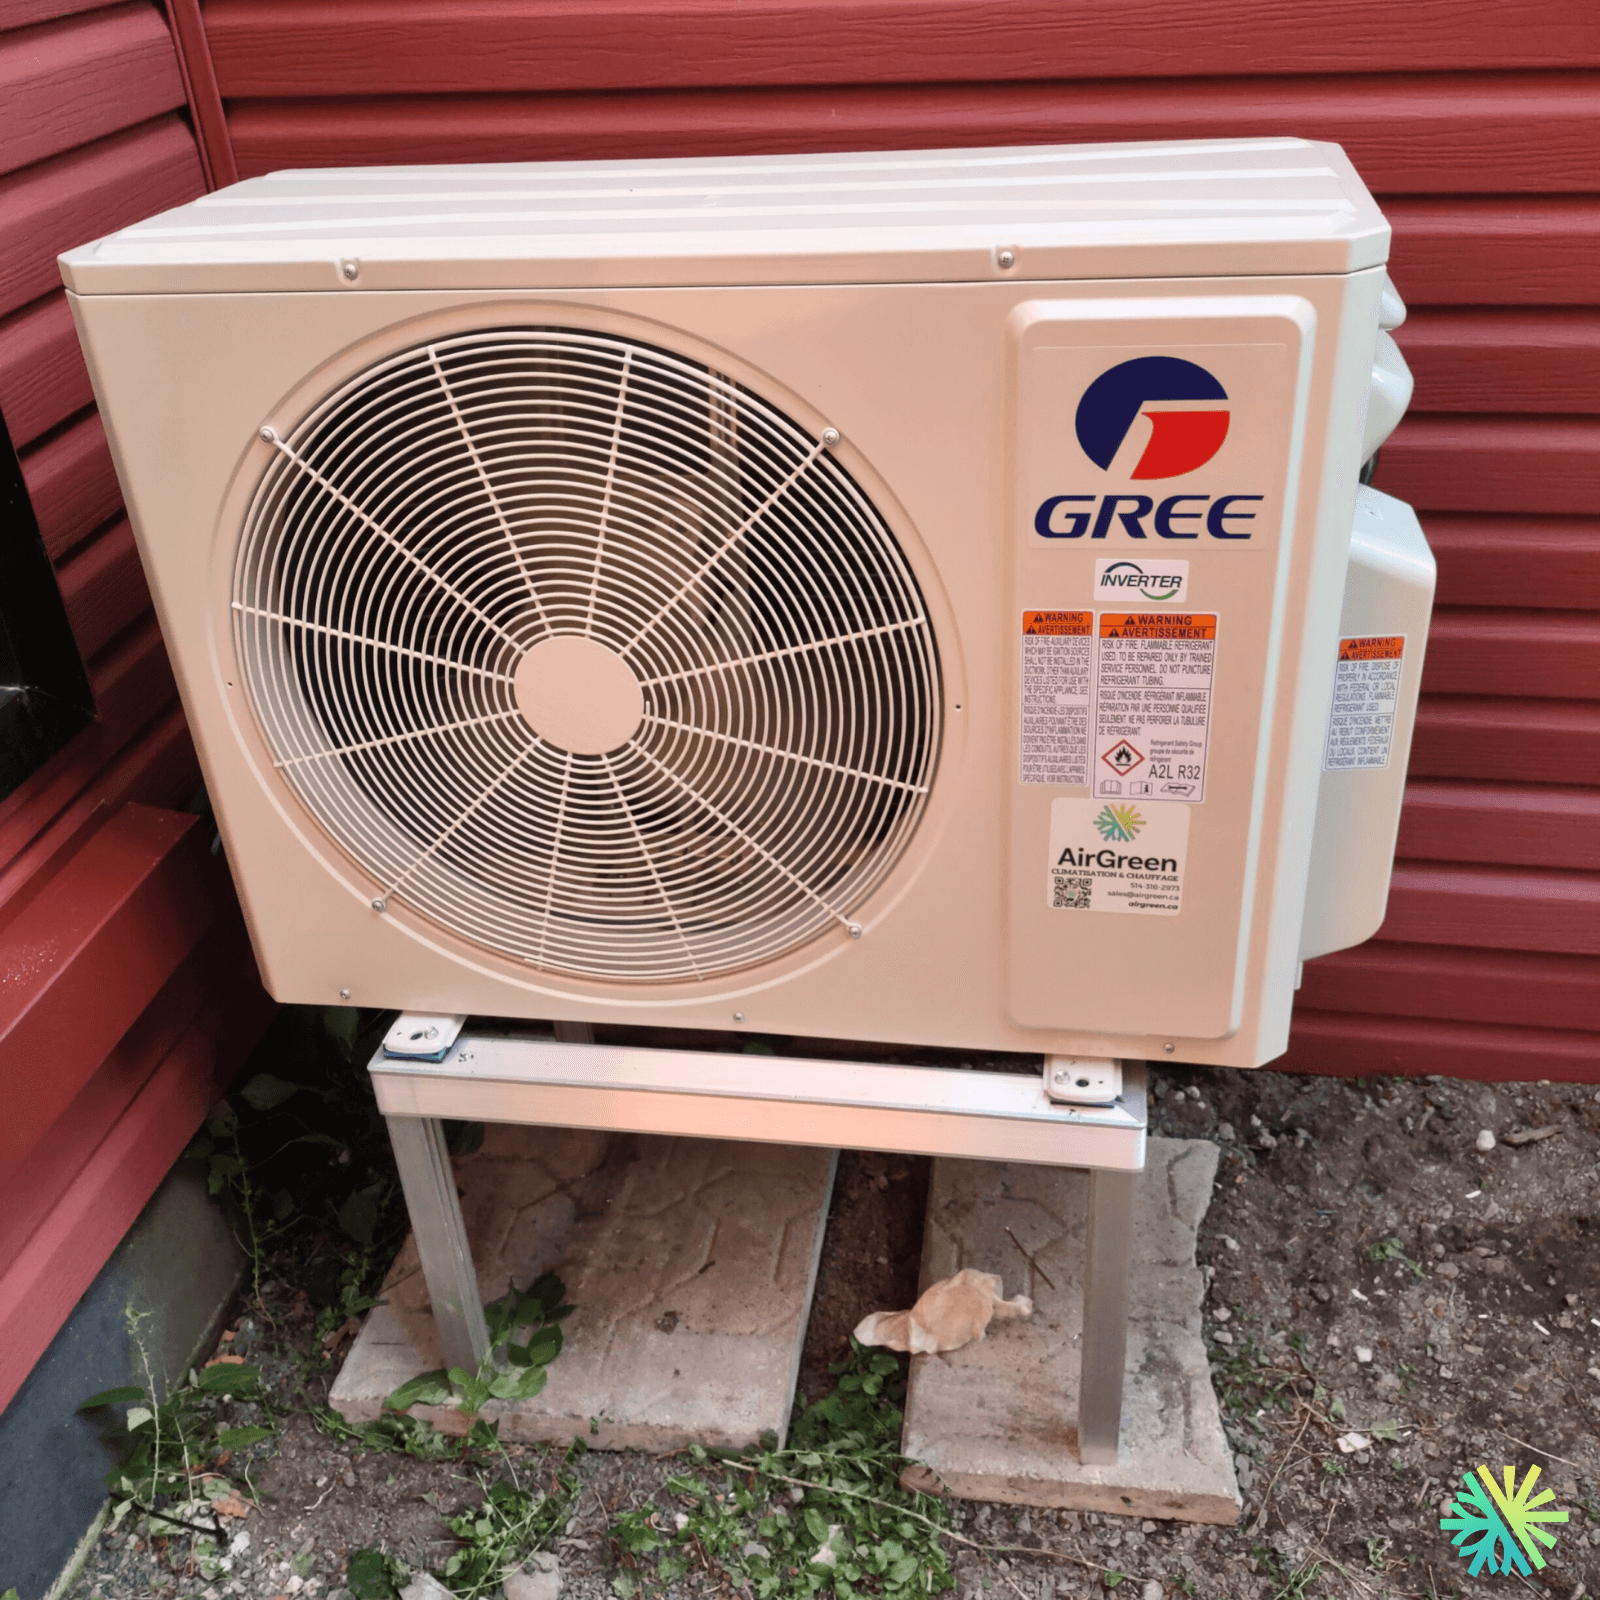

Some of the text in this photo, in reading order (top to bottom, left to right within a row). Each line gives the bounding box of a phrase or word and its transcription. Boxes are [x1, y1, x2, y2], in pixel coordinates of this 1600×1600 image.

[1034, 494, 1265, 540] GREE
[1100, 574, 1182, 588] INVERTER
[1044, 614, 1084, 622] WARNING
[1139, 616, 1192, 626] WARNING
[1038, 625, 1090, 634] AVERTISSEMENT
[1122, 628, 1207, 638] AVERTISSEMENT
[1102, 640, 1114, 649] RISK
[1116, 640, 1123, 649] OF
[1141, 640, 1172, 650] FLAMMABLE
[1174, 641, 1213, 650] REFRIGERANT
[1360, 638, 1396, 648] WARNING
[1119, 652, 1126, 661] TO
[1128, 652, 1135, 661] BE
[1137, 652, 1162, 661] REPAIRED
[1164, 653, 1178, 662] ONLY
[1180, 653, 1187, 662] BY
[1189, 653, 1212, 662] TRAINED
[1101, 664, 1123, 673] SERVICE
[1159, 664, 1167, 673] DO
[1169, 664, 1181, 674] NOT
[1182, 665, 1211, 674] PUNCTURE
[1100, 675, 1140, 684] REFRIGERANT
[1100, 690, 1116, 700] RISQUE
[1131, 702, 1140, 712] PAR
[1142, 703, 1152, 712] UNE
[1153, 703, 1179, 713] PERSONNE
[1129, 715, 1135, 724] NE
[1136, 715, 1145, 724] PAS
[1147, 715, 1172, 725] PERFORER
[1173, 716, 1179, 725] LA
[1181, 716, 1206, 726] TUBULURE
[1099, 726, 1105, 735] DE
[1148, 764, 1200, 779] A2L R32
[1058, 848, 1177, 872] AirGreen
[1051, 868, 1117, 878] CLIMATISATION
[1126, 873, 1178, 882] CHAUFFAGE
[1130, 882, 1180, 891] 514-316-2973
[1107, 890, 1179, 901] sales@airgreen.ca
[1128, 901, 1178, 910] airgreen.ca
